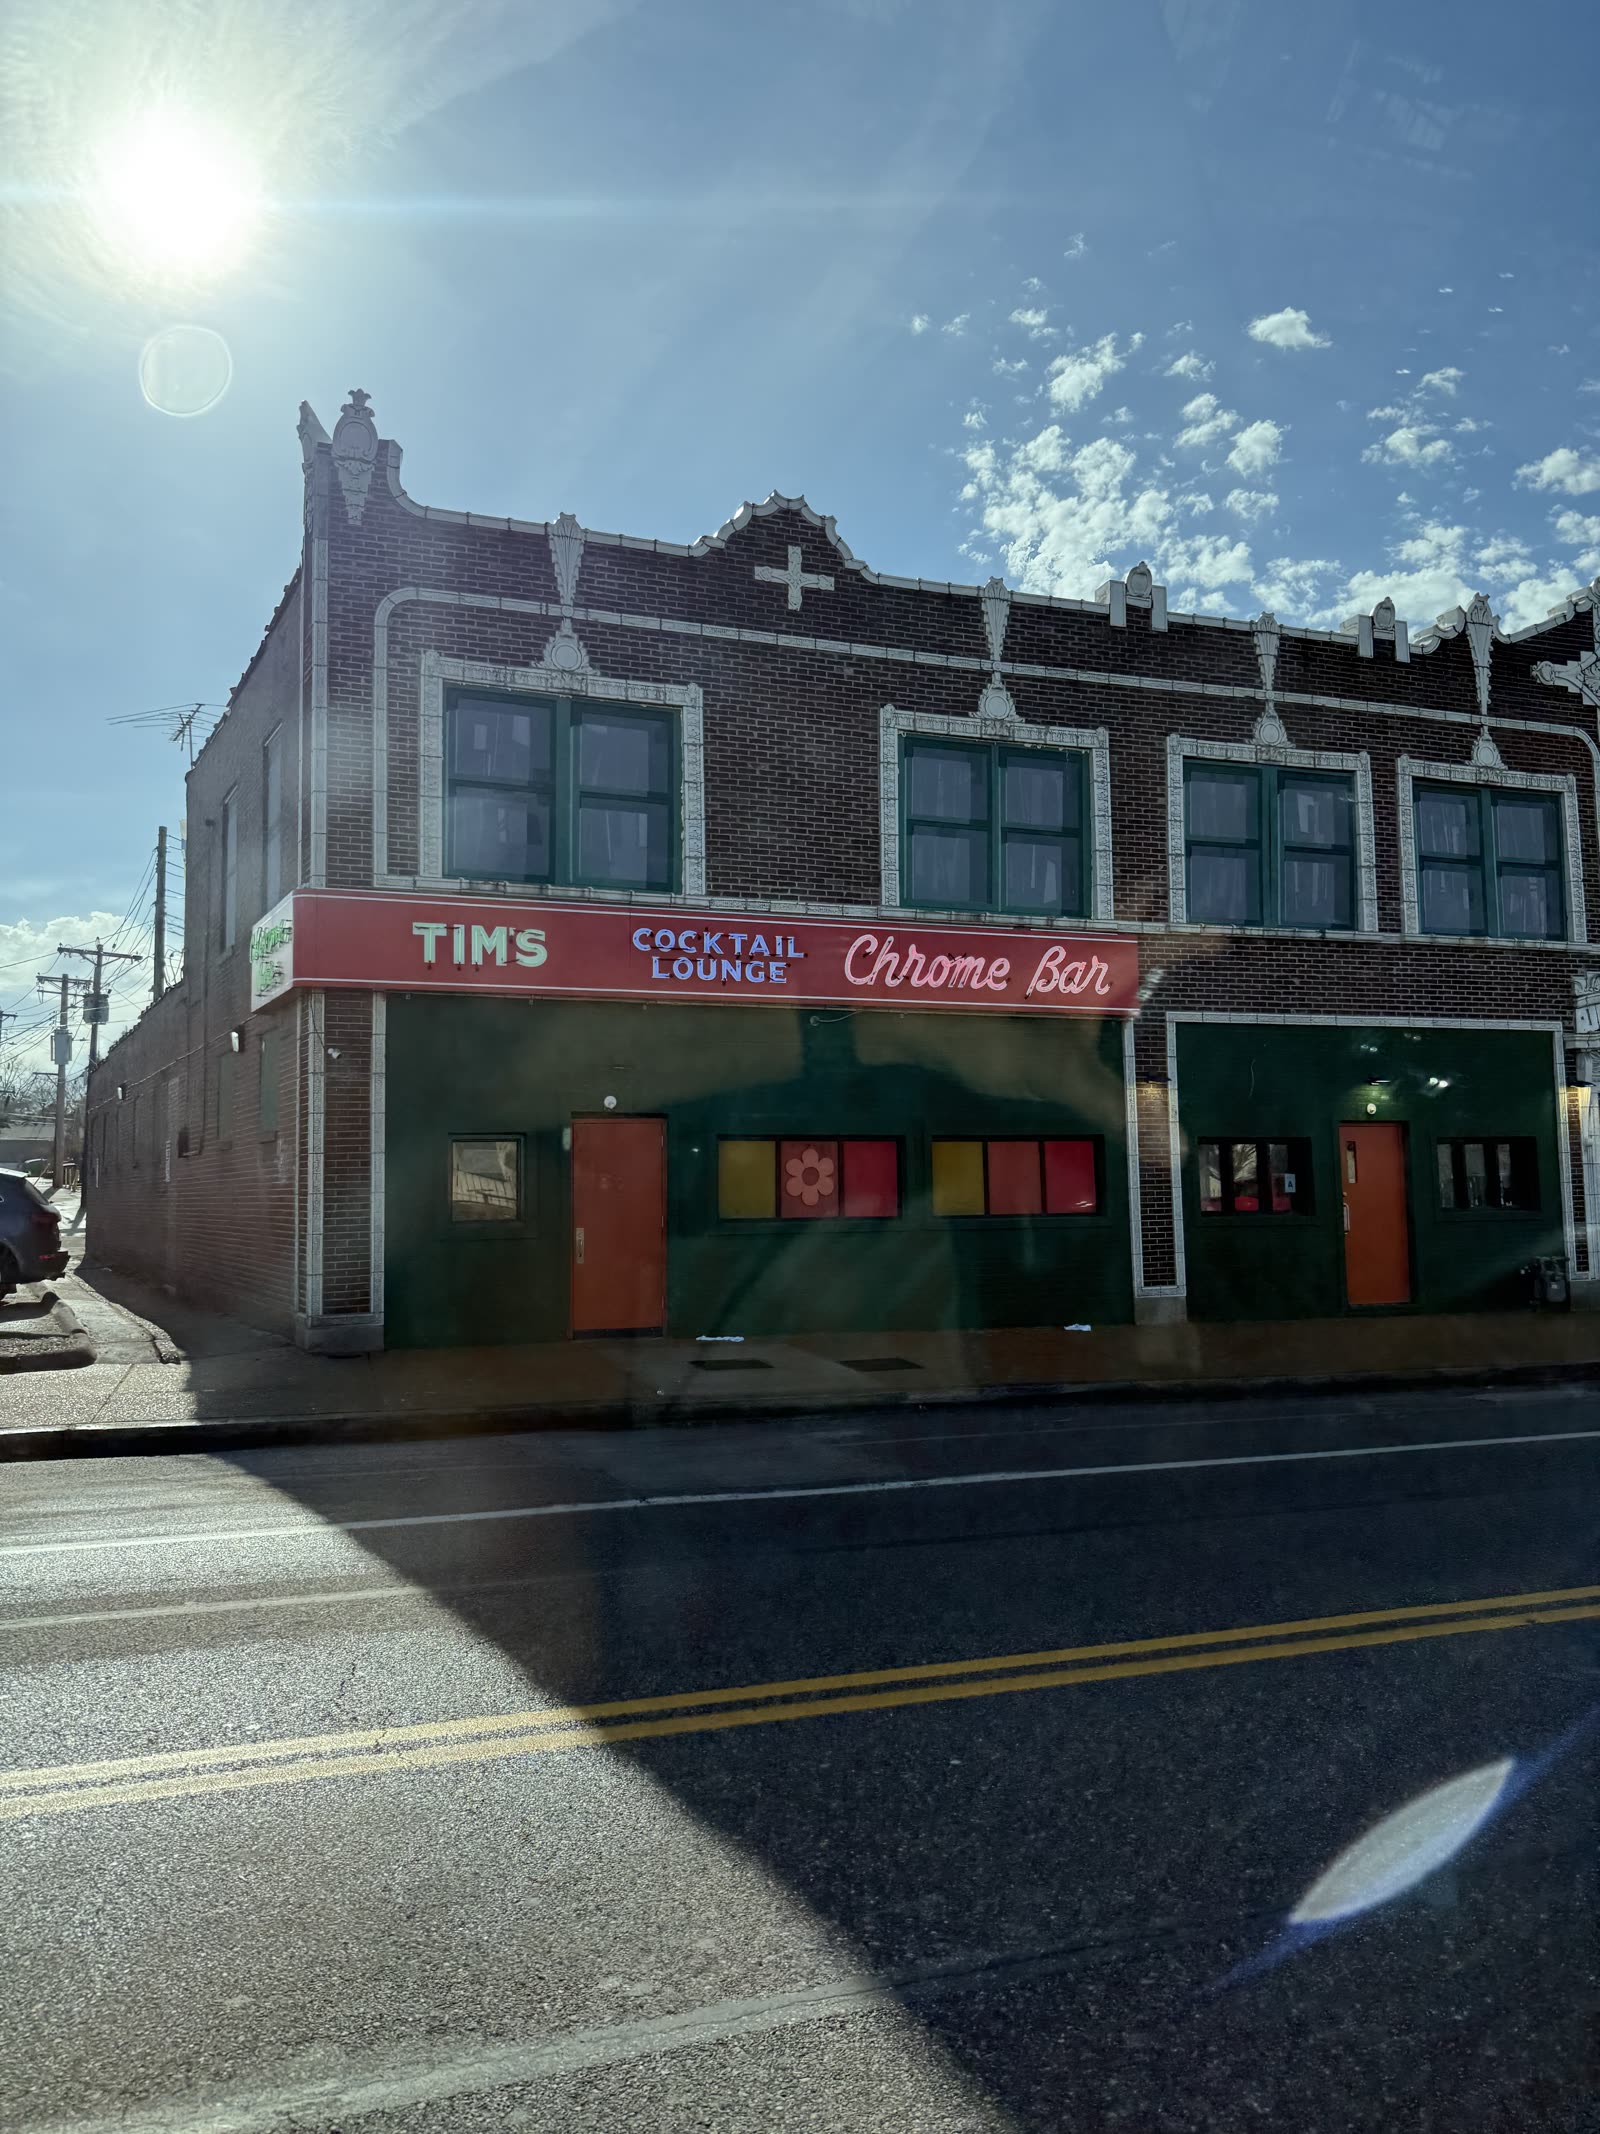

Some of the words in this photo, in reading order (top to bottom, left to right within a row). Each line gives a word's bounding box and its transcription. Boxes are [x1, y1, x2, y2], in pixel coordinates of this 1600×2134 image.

[412, 922, 548, 967] TIM'S
[632, 927, 804, 958] COCKTAIL
[652, 956, 787, 983] LOUNGE
[844, 934, 1010, 991] Chrome
[1027, 945, 1110, 996] Bar
